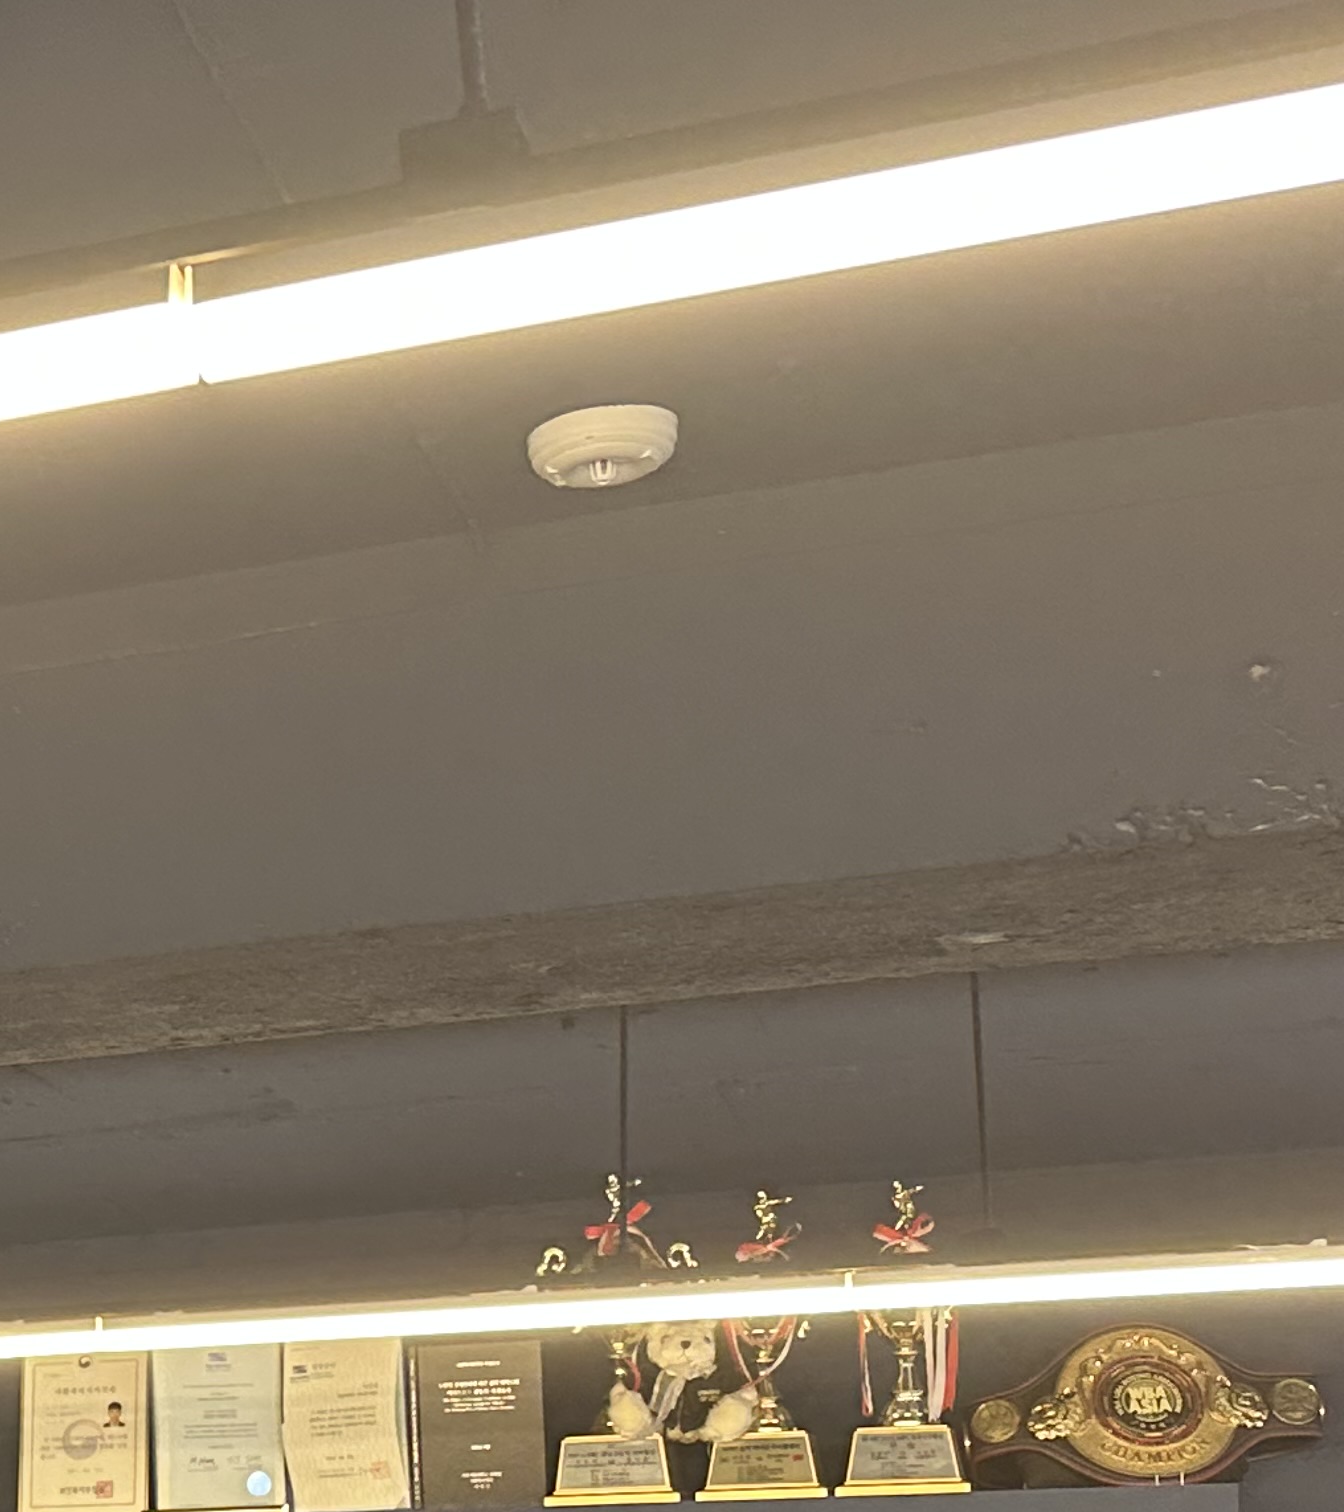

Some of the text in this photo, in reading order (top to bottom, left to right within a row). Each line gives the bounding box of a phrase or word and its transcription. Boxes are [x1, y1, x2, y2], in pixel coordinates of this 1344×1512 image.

[1128, 1386, 1167, 1400] WBA
[1129, 1398, 1173, 1413] ASIA
[1099, 1437, 1210, 1464] CHAMPION
